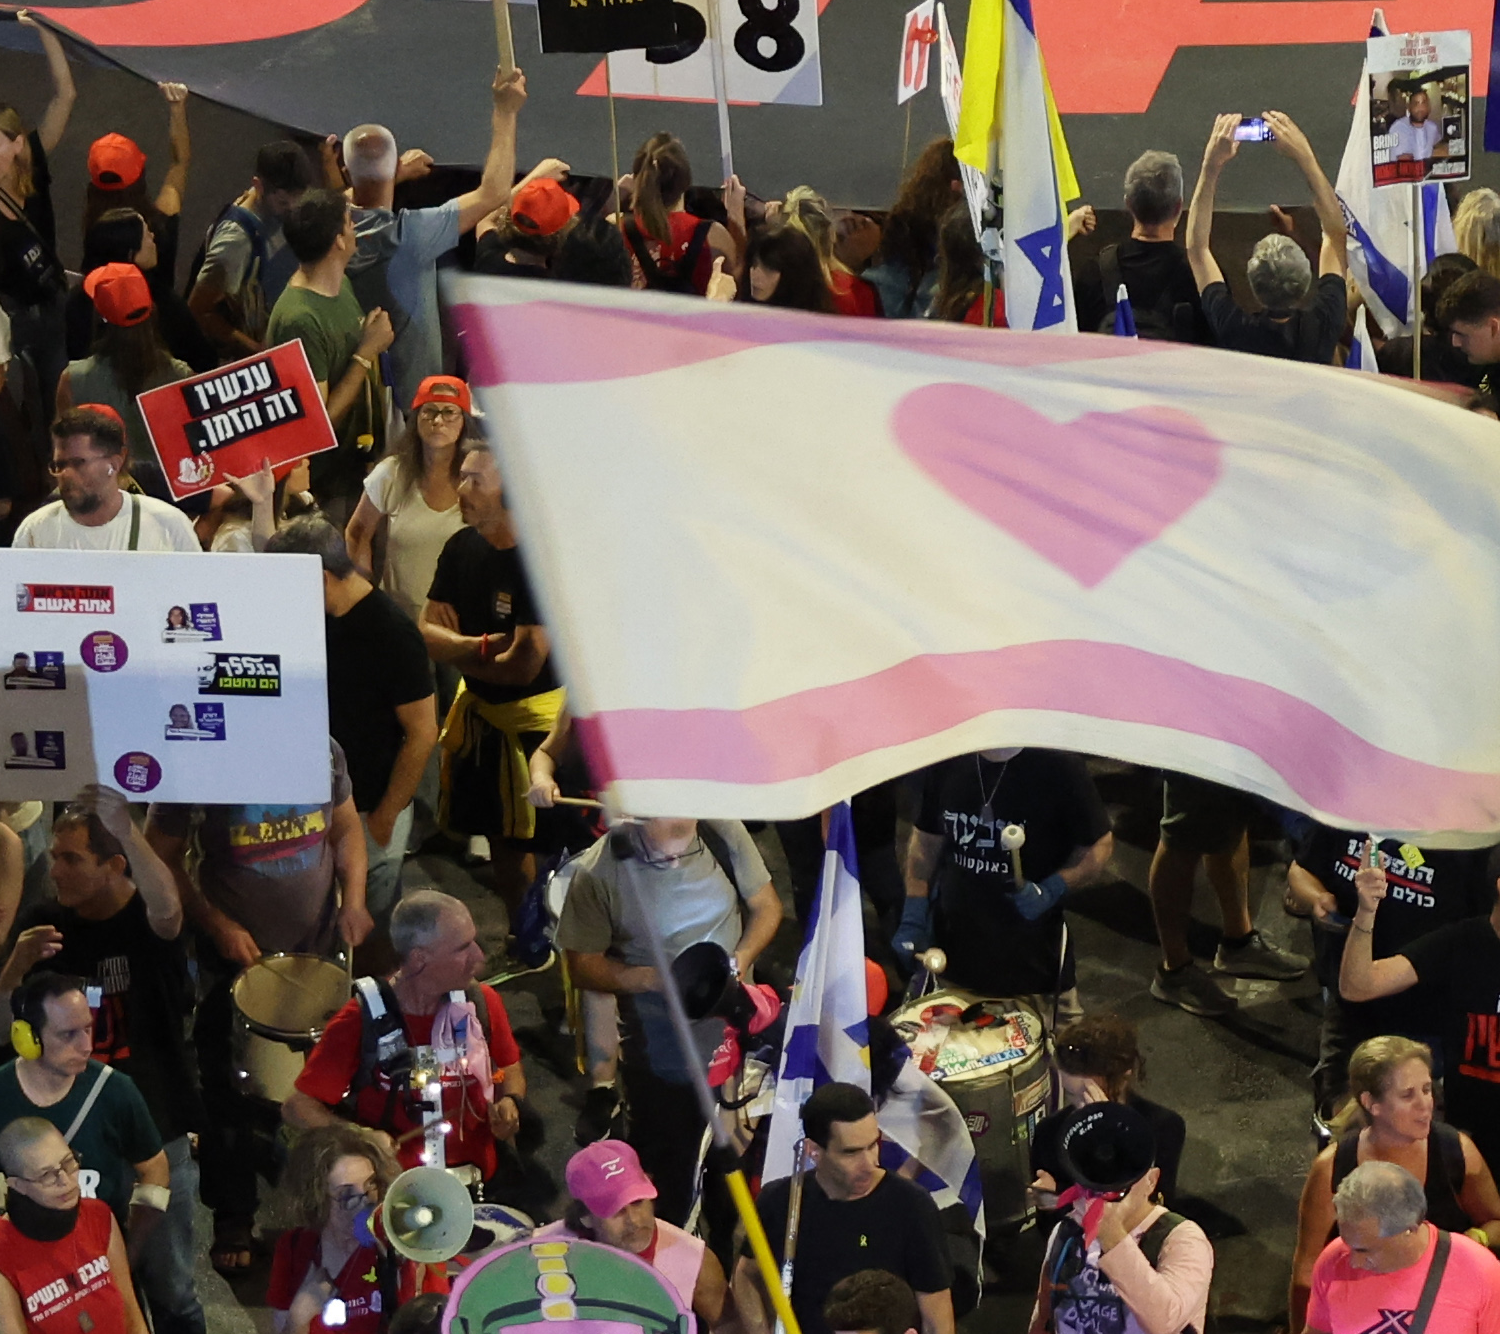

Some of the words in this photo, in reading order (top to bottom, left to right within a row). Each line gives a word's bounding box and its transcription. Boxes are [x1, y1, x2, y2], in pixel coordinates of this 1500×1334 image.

[1371, 134, 1398, 150] BRING
[193, 362, 273, 412] עכשיו
[257, 388, 296, 422] זה
[32, 599, 76, 614] אשם
[79, 598, 112, 613] אתה
[215, 657, 277, 677] בגללך
[217, 676, 257, 693] נחטפו
[260, 676, 278, 691] הם
